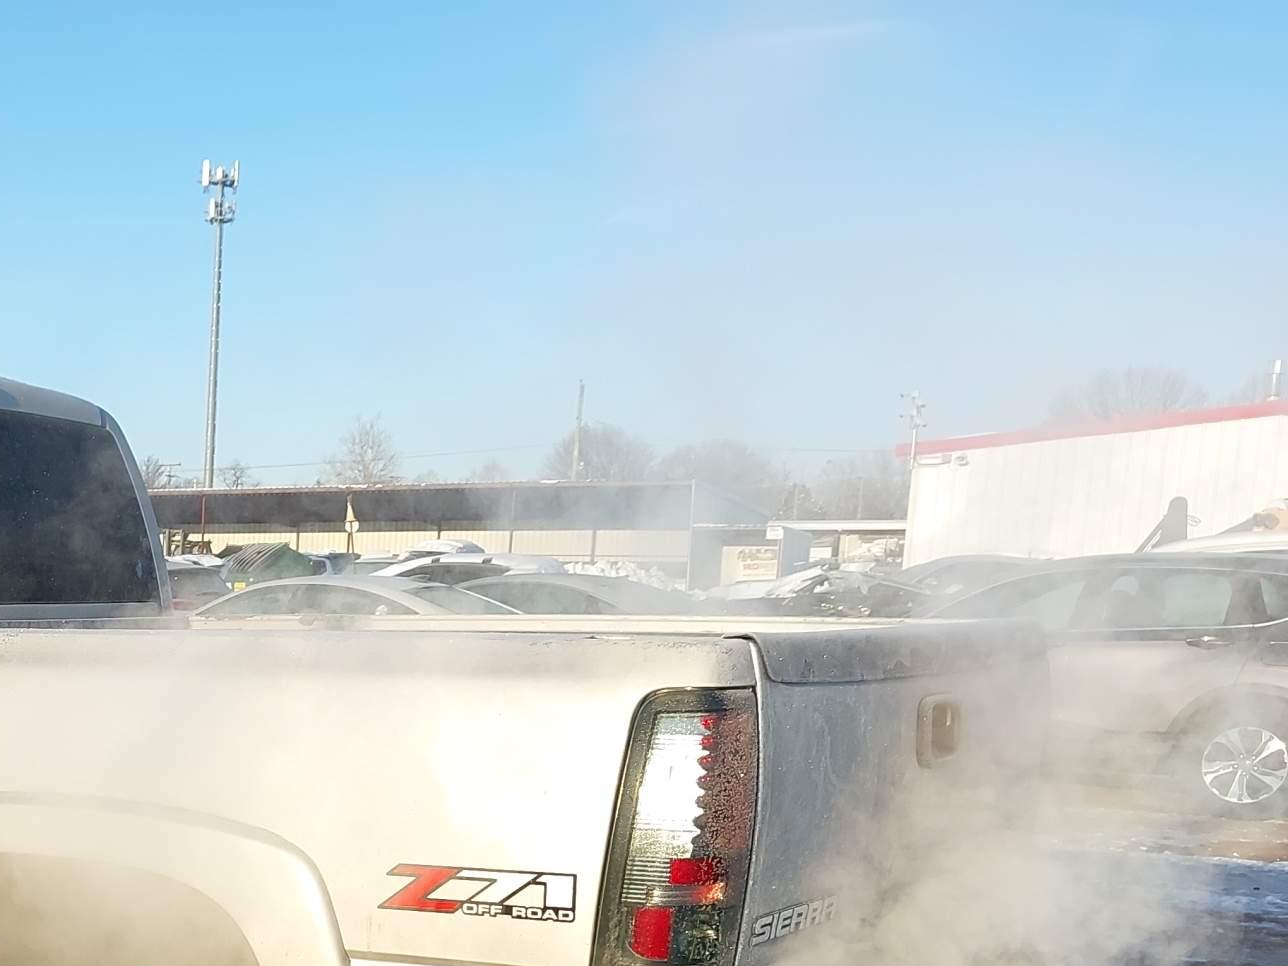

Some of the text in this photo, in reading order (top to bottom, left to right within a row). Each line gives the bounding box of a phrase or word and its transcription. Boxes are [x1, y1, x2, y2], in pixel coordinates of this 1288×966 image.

[377, 863, 577, 914] Z71
[462, 901, 576, 923] OFF ROAD
[749, 895, 839, 948] SIERRA
